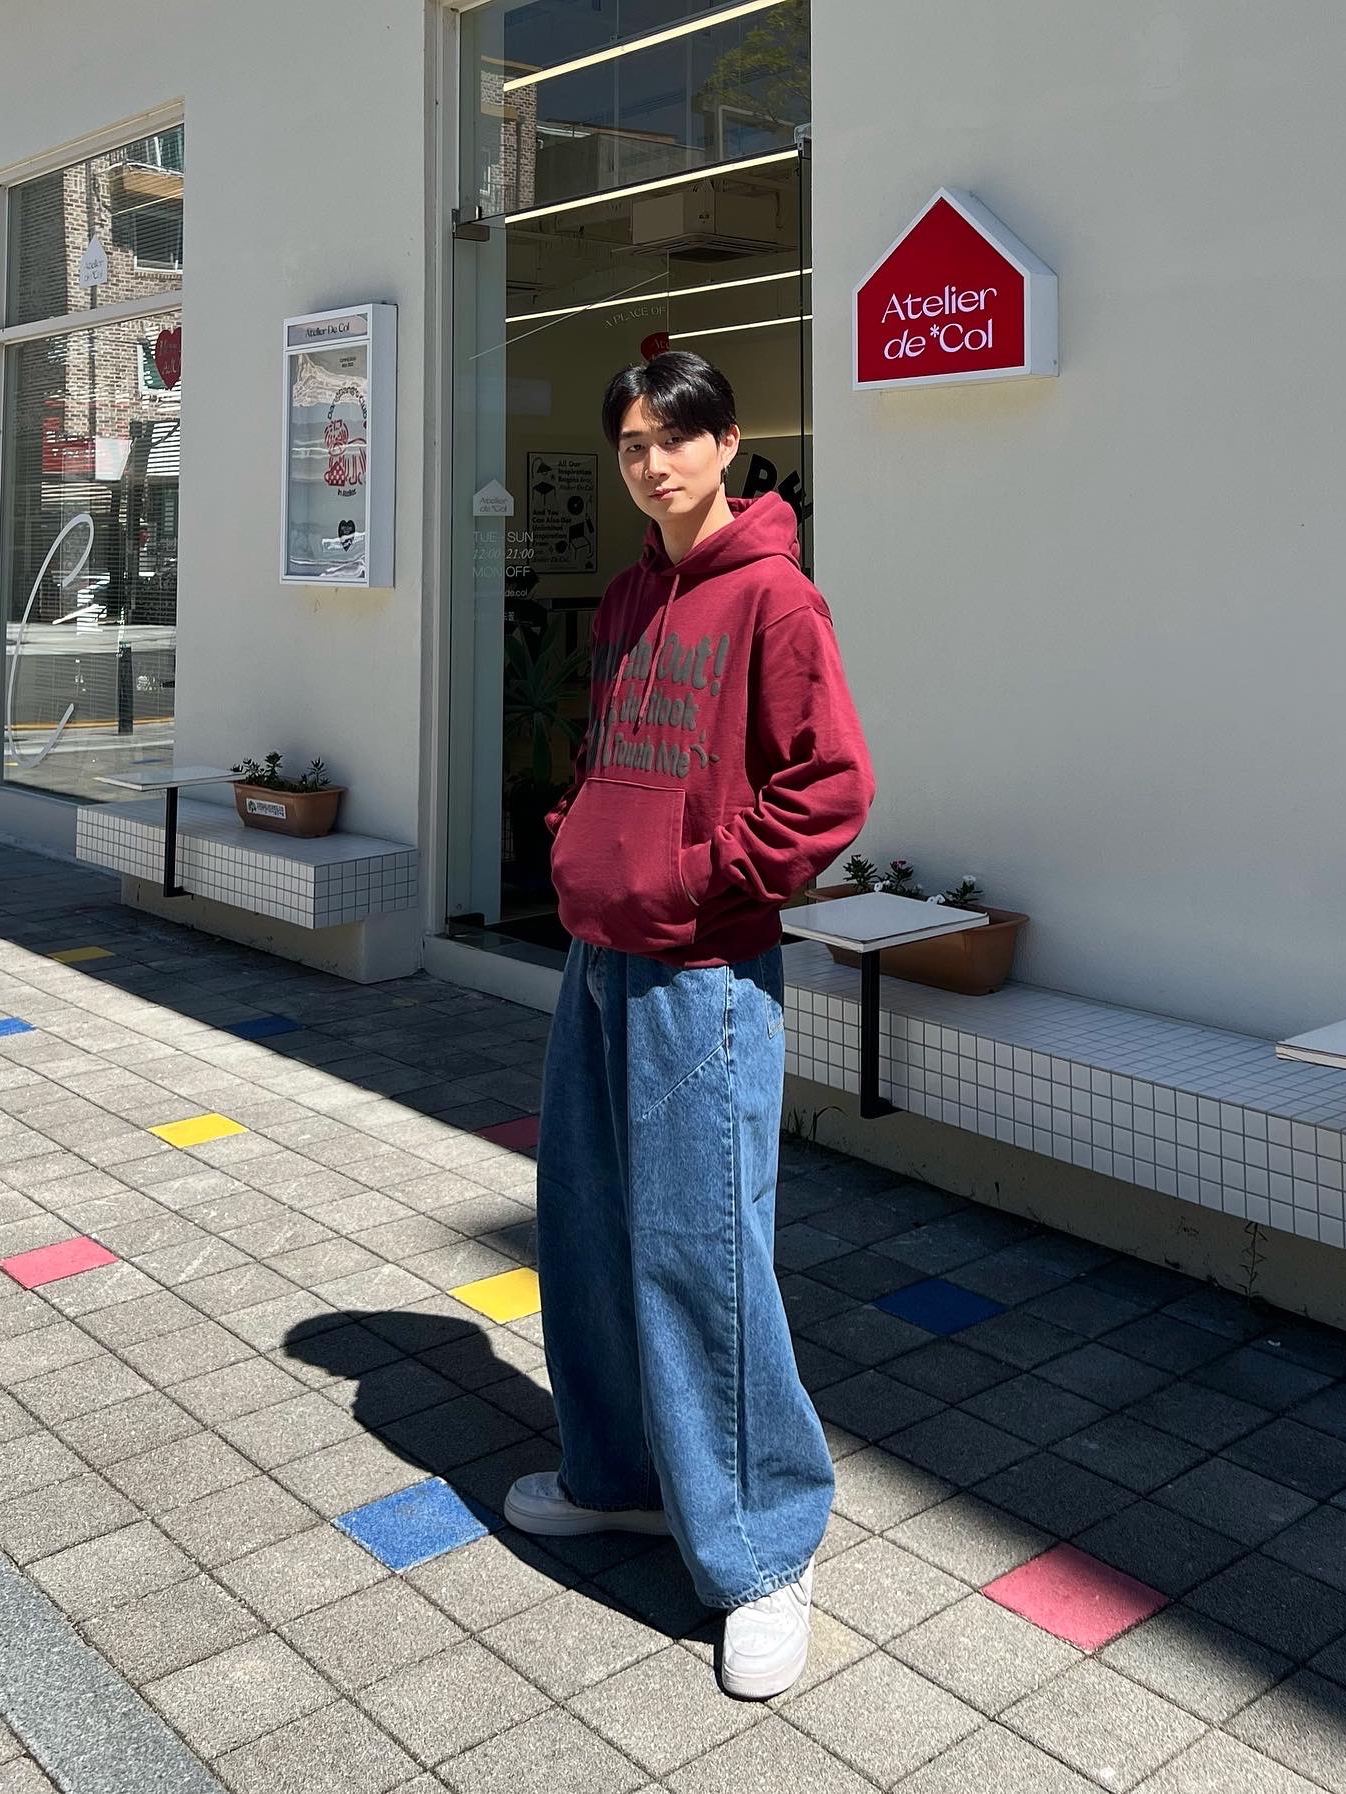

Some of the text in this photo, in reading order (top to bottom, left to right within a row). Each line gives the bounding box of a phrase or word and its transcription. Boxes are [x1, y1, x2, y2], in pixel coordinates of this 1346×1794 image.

[881, 284, 998, 324] Atelier
[884, 329, 927, 360] de
[473, 531, 498, 543] TUE
[506, 531, 534, 543] SUN
[505, 548, 535, 560] 21:00
[472, 566, 503, 578] MON
[505, 565, 531, 578] OFF
[657, 631, 730, 697] Out!
[654, 738, 691, 779] Me
